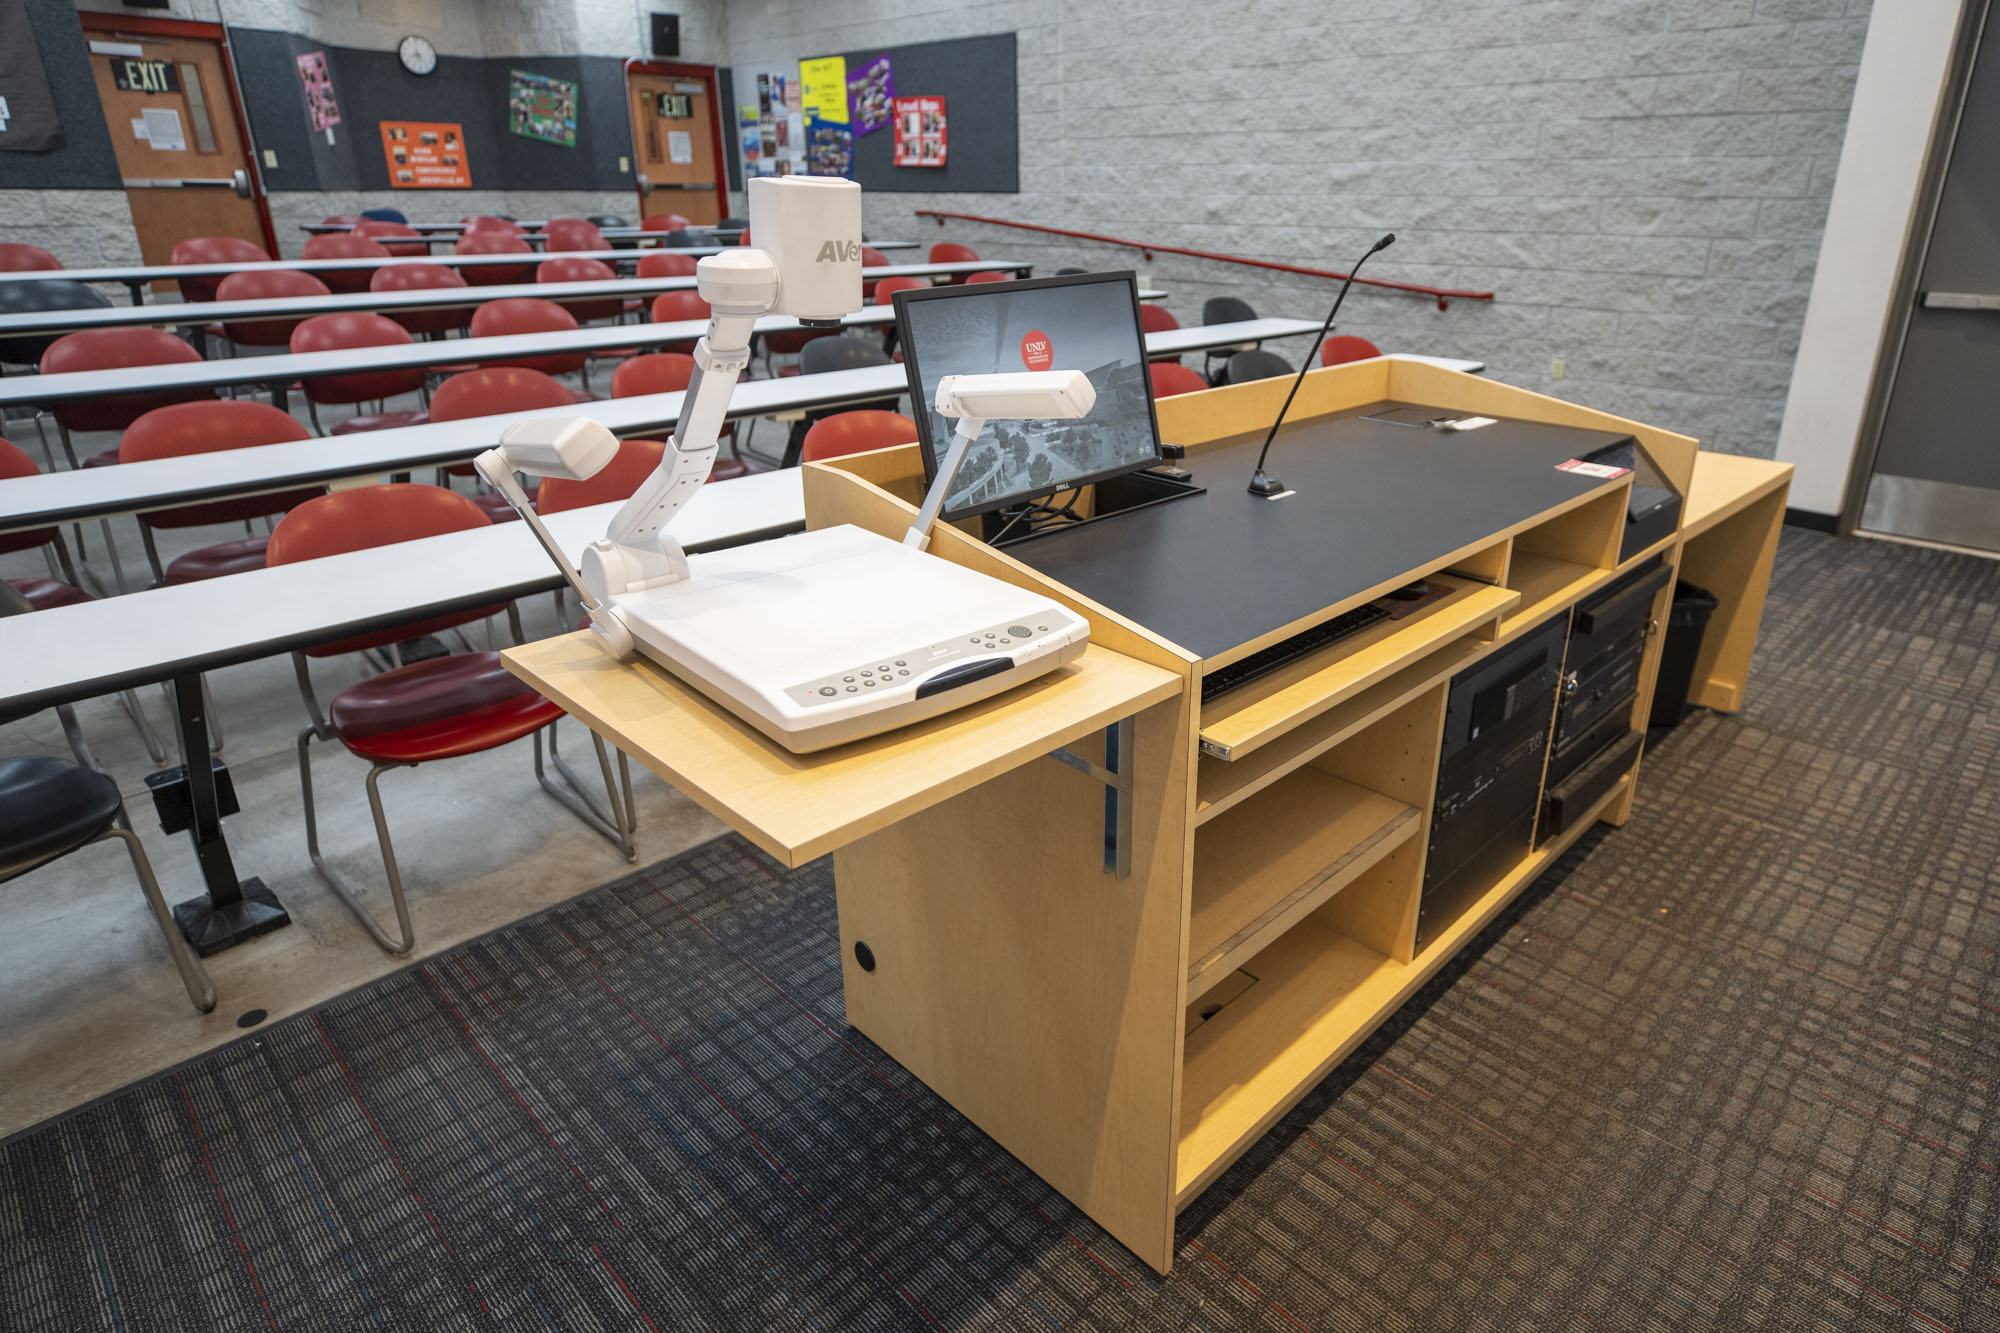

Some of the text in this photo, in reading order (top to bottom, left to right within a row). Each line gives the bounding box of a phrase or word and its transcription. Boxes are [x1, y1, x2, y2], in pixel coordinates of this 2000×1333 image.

[124, 61, 168, 91] EXIT
[663, 94, 688, 116] EXIT
[815, 240, 861, 262] AVer
[1026, 341, 1047, 352] UNLV
[1055, 482, 1070, 491] DELL
